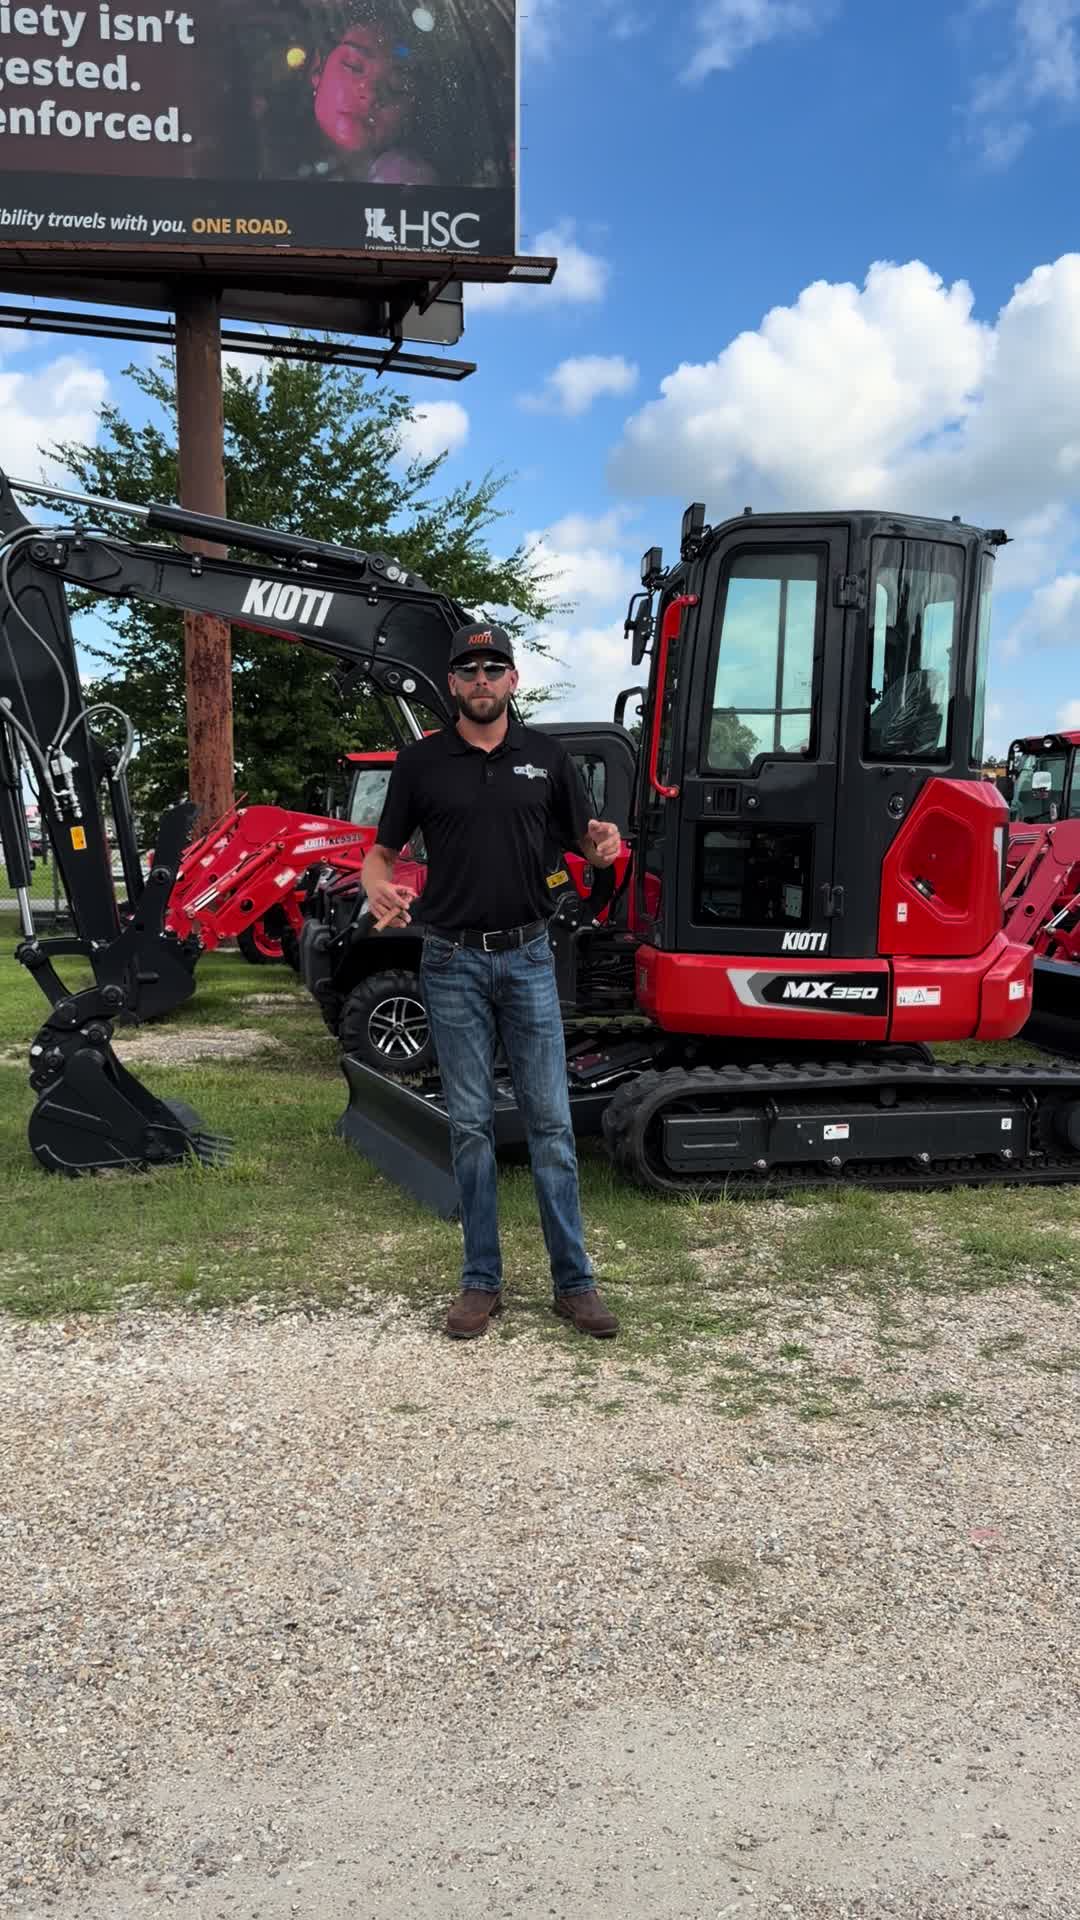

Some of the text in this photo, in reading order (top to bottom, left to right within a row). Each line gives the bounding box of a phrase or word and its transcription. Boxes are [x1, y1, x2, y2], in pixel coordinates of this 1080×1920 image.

[0, 0, 195, 48] iety isn't
[0, 54, 141, 92] ested.
[0, 99, 193, 143] nforced.
[48, 211, 105, 229] travels
[110, 214, 148, 231] with
[150, 219, 187, 236] you.
[191, 217, 231, 234] ONE
[235, 218, 292, 235] ROAD.
[400, 209, 480, 248] HSC
[241, 578, 334, 627] KIOTI
[781, 932, 828, 951] KIOTI
[782, 981, 879, 999] MX350
